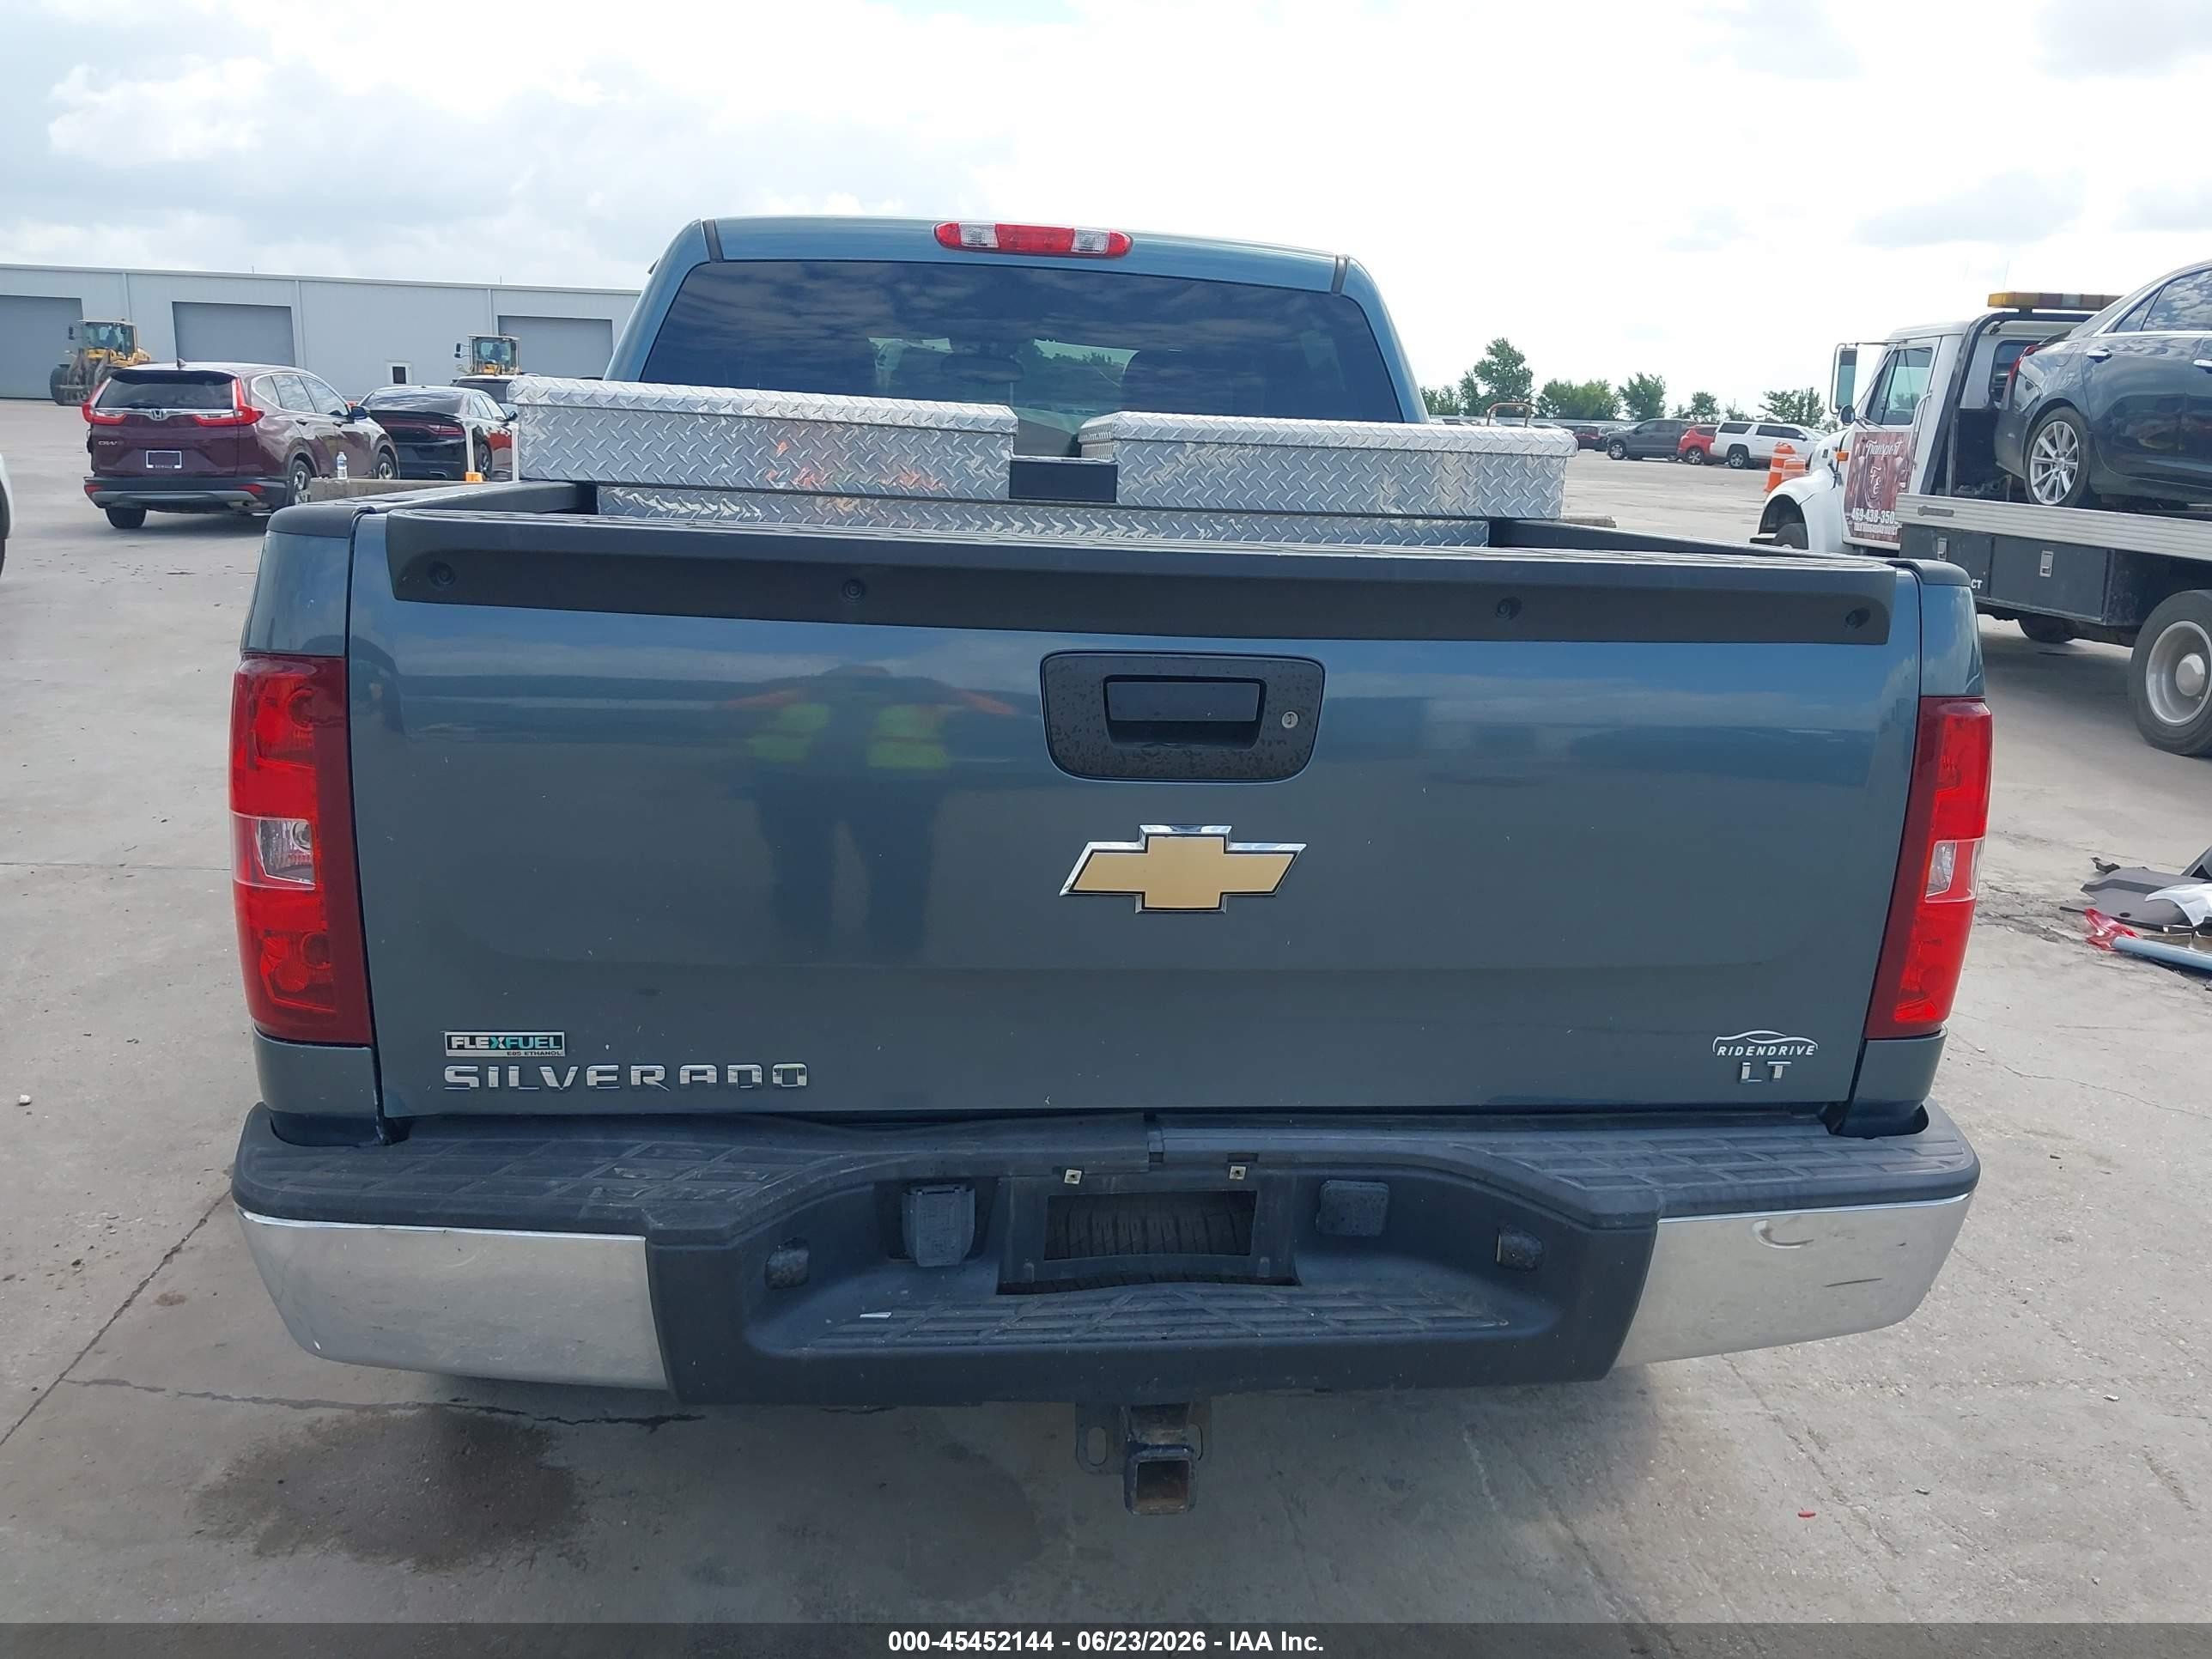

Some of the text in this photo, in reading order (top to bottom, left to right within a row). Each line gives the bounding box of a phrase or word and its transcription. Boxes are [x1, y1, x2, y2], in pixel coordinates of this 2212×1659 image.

[451, 1036, 562, 1049] FLEXFUEL
[1717, 1045, 1815, 1057] RIDENDRIVE
[444, 1062, 808, 1092] SILVERADO
[1741, 1061, 1792, 1083] LT
